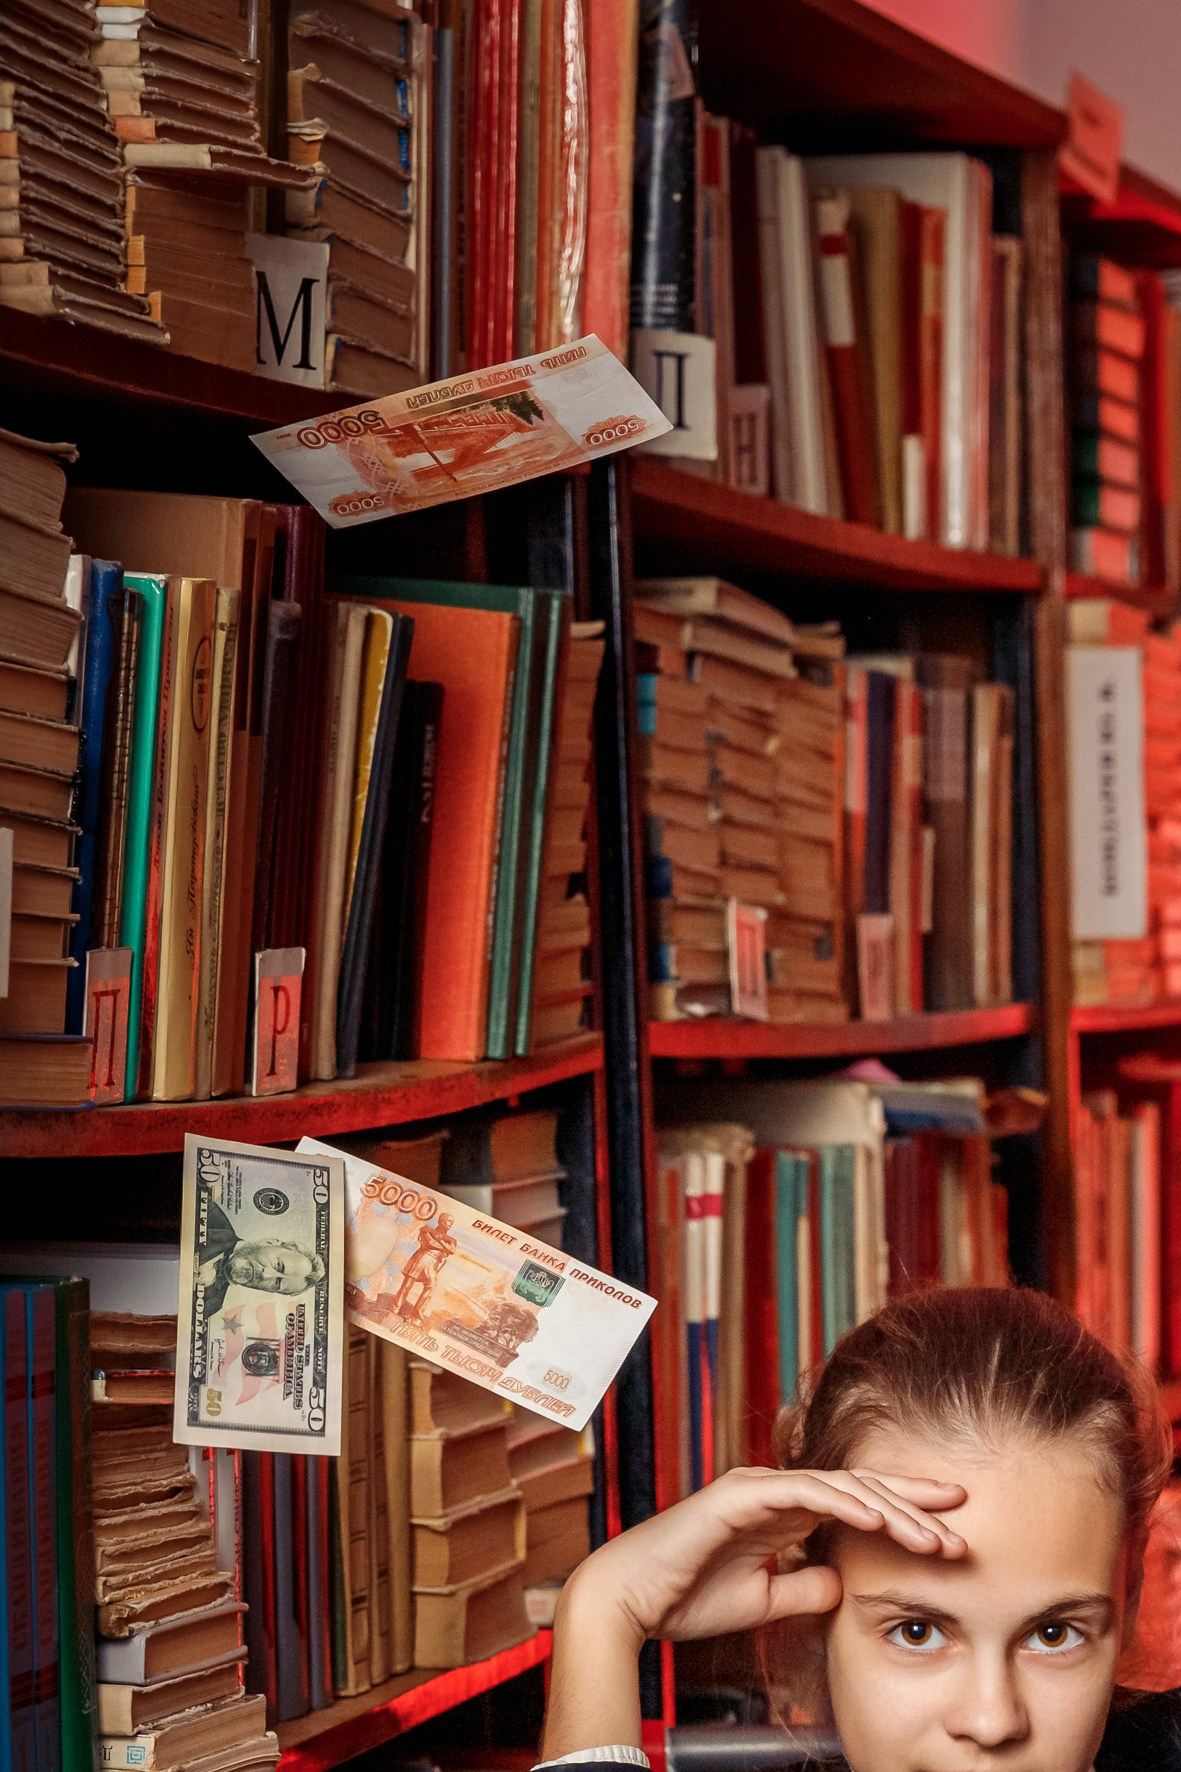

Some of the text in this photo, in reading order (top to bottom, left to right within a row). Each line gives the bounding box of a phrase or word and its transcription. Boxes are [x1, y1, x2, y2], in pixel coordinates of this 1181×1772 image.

[256, 271, 320, 371] М
[405, 345, 588, 411] ПЯТЬ ТЫСЯЧ ДУБЛЕЙ
[651, 350, 692, 432] П
[296, 408, 385, 449] 5000
[588, 419, 640, 446] 5000
[337, 497, 385, 515] 5000
[87, 988, 121, 1090] П
[266, 985, 292, 1077] Р
[199, 1149, 220, 1248] 50 FIFTY
[313, 1168, 329, 1205] 50
[358, 1172, 441, 1223] 5000
[471, 1219, 644, 1309] БИЛЕТ БАНКА ПРИКОЛОВ
[192, 1283, 205, 1379] DOLLARS
[283, 1312, 295, 1401] OF AMERICA
[294, 1303, 305, 1411] UNITED STATES
[390, 1320, 577, 1418] ПЯТЬ ТЫСЯЧ ДУБЛЕЙ
[206, 1388, 223, 1417] 50
[308, 1386, 325, 1432] 50
[542, 1368, 571, 1392] 5000
